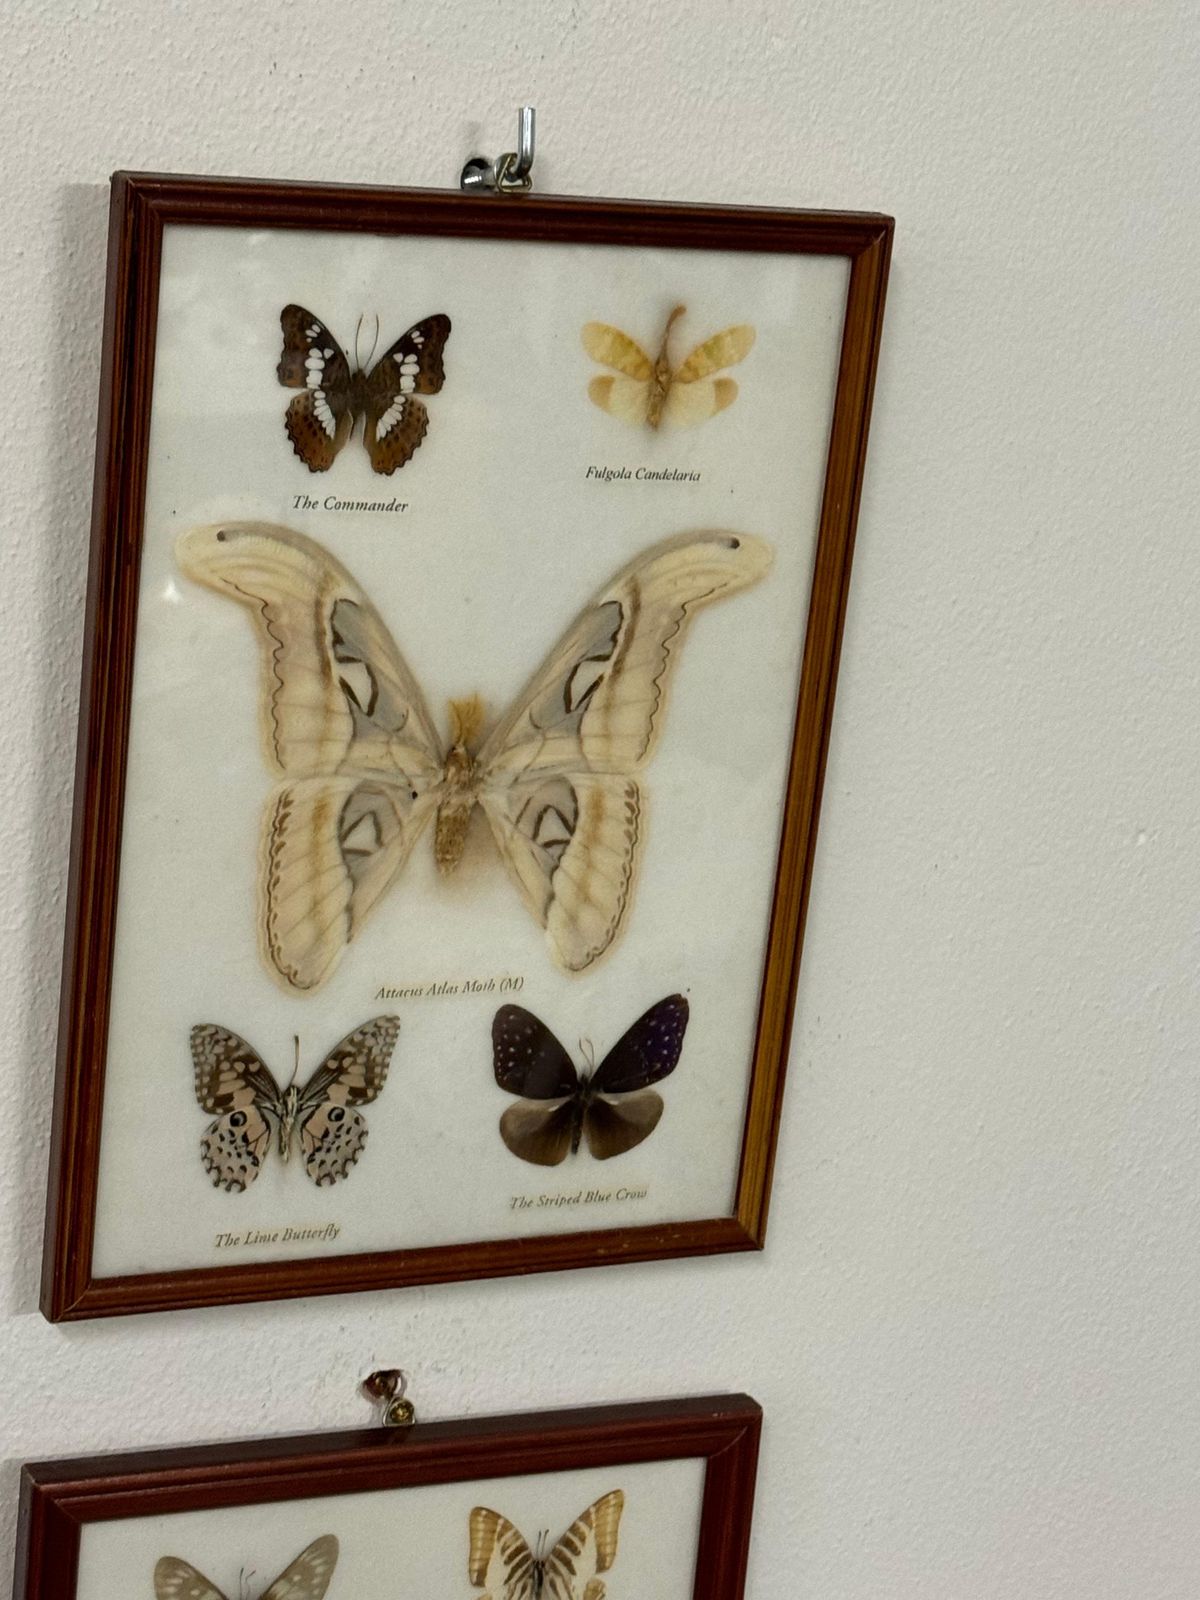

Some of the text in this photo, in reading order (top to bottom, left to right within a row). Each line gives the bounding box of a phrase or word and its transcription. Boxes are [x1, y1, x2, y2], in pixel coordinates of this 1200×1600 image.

[585, 466, 701, 482] Fulgola Candelaria
[292, 495, 409, 512] The Commander
[374, 976, 524, 1000] Attacus Atlas Moth (M)
[511, 1188, 648, 1210] The Striped Blue Crow
[214, 1223, 341, 1248] The Lime Butterfly
